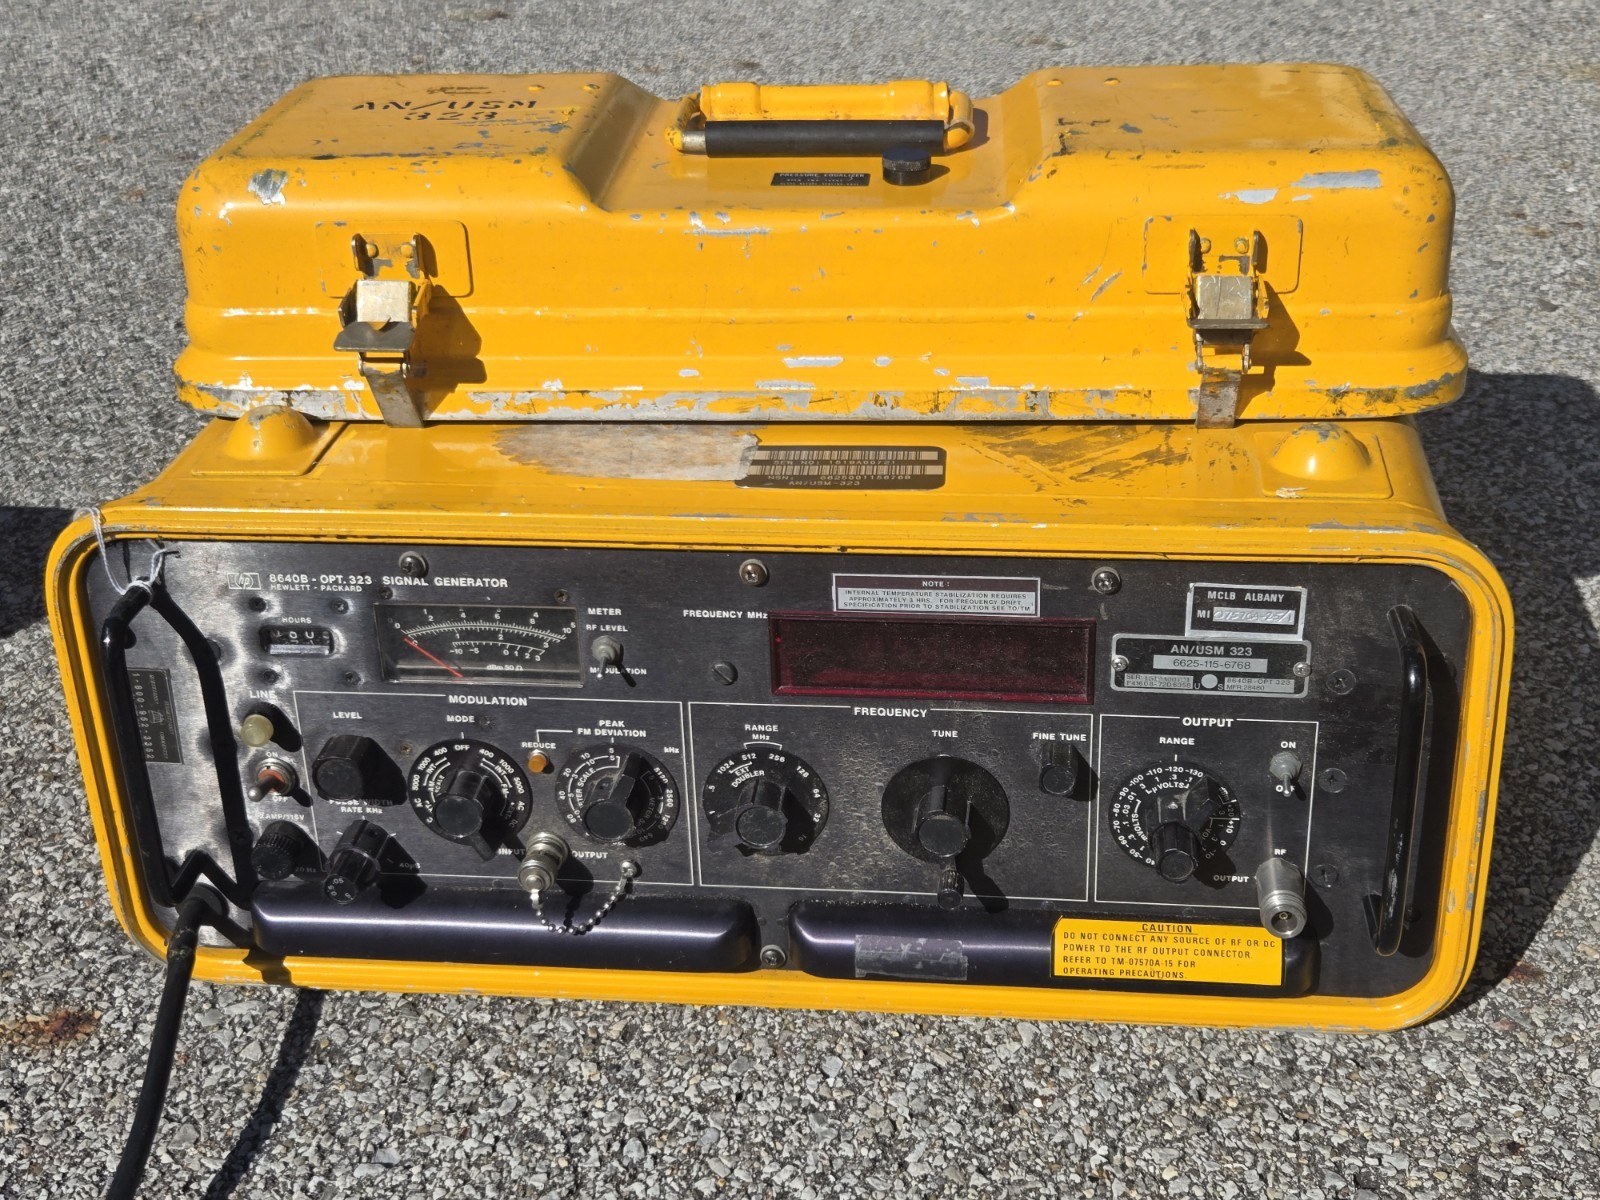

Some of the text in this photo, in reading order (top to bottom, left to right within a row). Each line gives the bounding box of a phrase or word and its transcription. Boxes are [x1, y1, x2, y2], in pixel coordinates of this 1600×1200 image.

[352, 100, 537, 111] AN/USM
[403, 111, 498, 121] 323
[269, 573, 509, 588] 8640B OPT. 323 SIGNAL GENERATOR
[270, 584, 363, 593] HEWLETT PACKARD
[1207, 590, 1285, 603] MCLB ALBANY
[587, 607, 622, 616] METER
[683, 609, 769, 620] FREQUENCY MHz
[1196, 609, 1211, 619] MI
[281, 616, 312, 624] HOURS
[600, 624, 629, 632] LEVEL
[1170, 644, 1253, 656] AN/USM 323
[1173, 658, 1251, 670] 6625-115-6768
[1194, 682, 1224, 691] U S
[249, 690, 278, 699] LINE
[448, 694, 528, 706] MODULATION
[332, 711, 363, 720] LEVEL
[854, 706, 927, 718] FREQUENCY
[446, 714, 475, 723] MODE
[599, 720, 625, 728] PEAK
[1182, 717, 1234, 728] OUTPUT
[577, 728, 647, 738] FM DEVIATION
[744, 724, 779, 732] RANGE
[931, 729, 958, 738] TUNE
[752, 733, 770, 741] MHz
[1032, 732, 1087, 742] FINE TUNE
[1159, 736, 1195, 746] RANGE
[454, 744, 470, 752] OFF
[521, 741, 556, 750] REDUCE
[663, 746, 680, 754] kHz
[1280, 741, 1297, 749] ON
[411, 746, 448, 791] 5000 1000 400
[585, 759, 596, 767] 10
[426, 763, 437, 775] INT
[479, 748, 525, 794] 400 1000 5000
[494, 765, 508, 777] INT
[734, 766, 750, 777] EXT
[1145, 767, 1163, 776] -110
[1184, 768, 1204, 778] -130
[558, 790, 566, 800] 40
[563, 767, 572, 778] 20
[580, 752, 591, 760] 10
[577, 767, 596, 787] SCALE
[730, 769, 765, 788] DOUBLER
[1129, 774, 1144, 787] -100
[427, 780, 435, 792] AM
[500, 783, 510, 795] FM
[716, 752, 821, 823] 1024 512 256 128 64 32
[666, 789, 674, 808] 2560
[1118, 786, 1129, 800] -90
[414, 797, 424, 808] AC
[517, 800, 526, 812] AC
[644, 796, 656, 820] METER
[1112, 803, 1121, 817] -80
[1112, 820, 1121, 833] -70
[1225, 819, 1235, 834] +10
[1118, 835, 1130, 848] -60
[571, 850, 608, 859] OUTPUT
[1274, 848, 1287, 856] RF
[1213, 874, 1250, 883] OUTPUT
[1141, 923, 1193, 933] CAUTION
[1063, 931, 1276, 948] DO NOT CONNECT ANY SOURCE OF RF OR DC
[1063, 943, 1253, 959] POWER TO THE RF OUTPUT CONNECTOR.
[1063, 955, 1092, 964] REFER
[1096, 956, 1107, 965] TO
[1177, 959, 1196, 968] FOR
[1063, 967, 1187, 979] OPERATING PRECAUTIONS.
